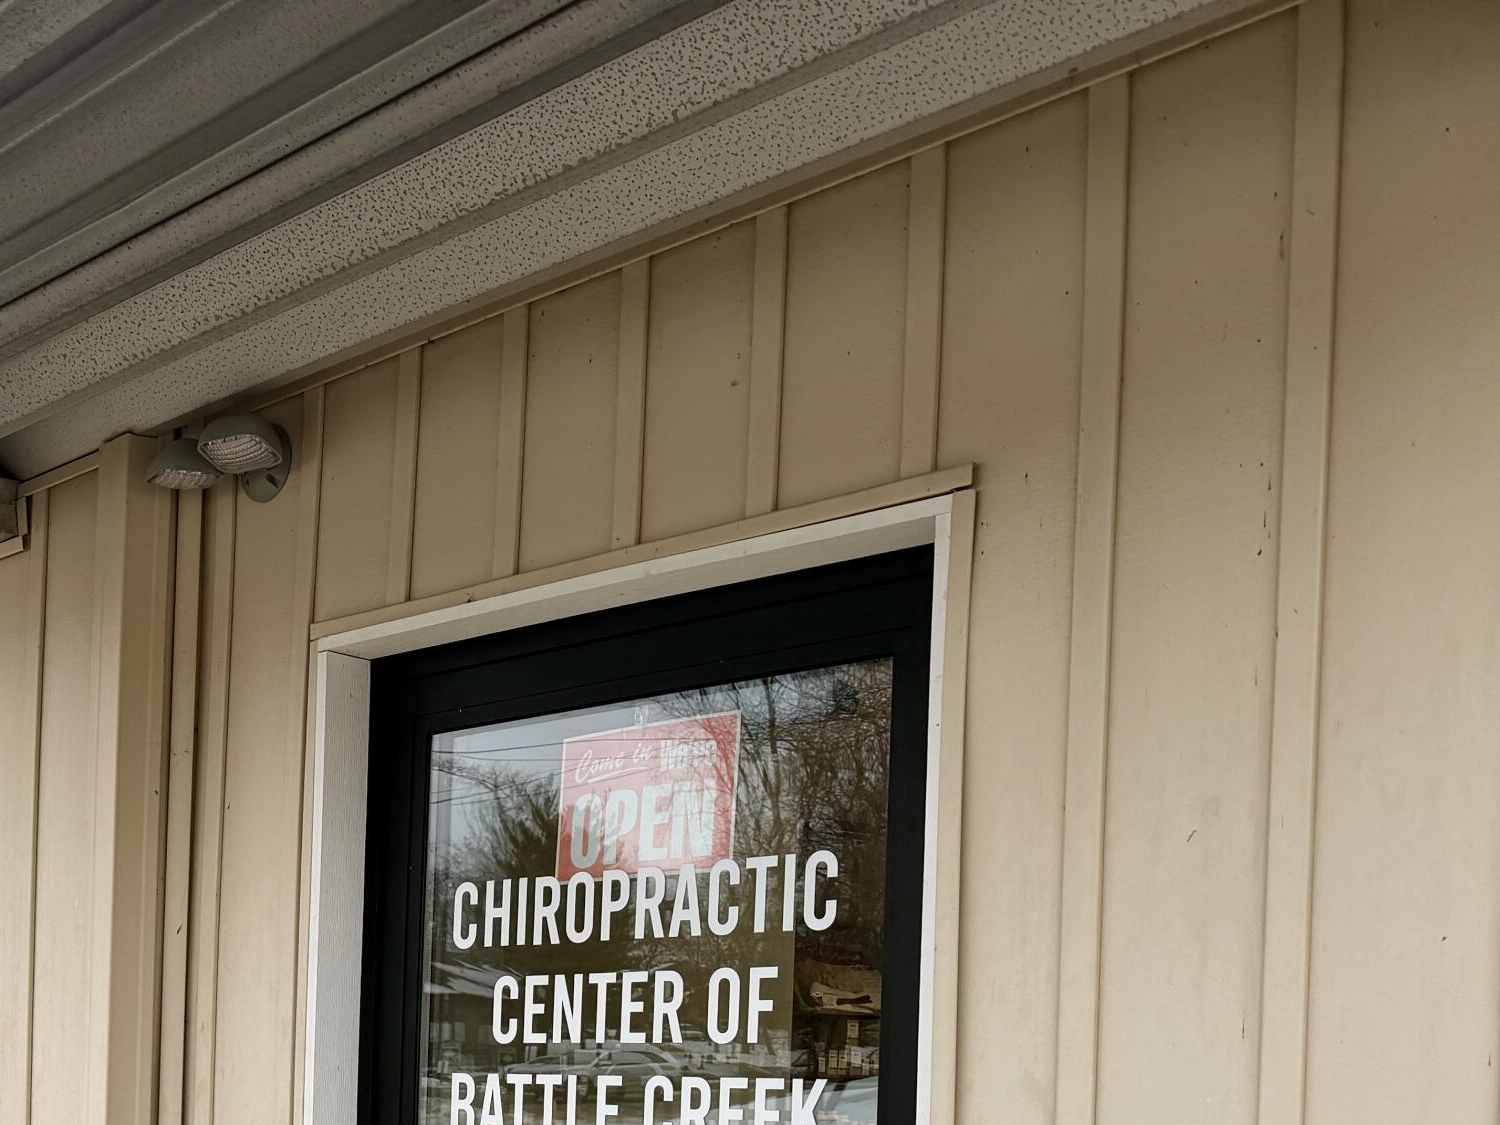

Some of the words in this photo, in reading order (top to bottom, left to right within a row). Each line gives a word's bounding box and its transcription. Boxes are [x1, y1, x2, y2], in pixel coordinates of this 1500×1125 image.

[570, 777, 718, 869] OPEN
[452, 849, 839, 950] CHIROPRACTIC
[492, 969, 685, 1045] CENTER
[706, 966, 779, 1045] OF
